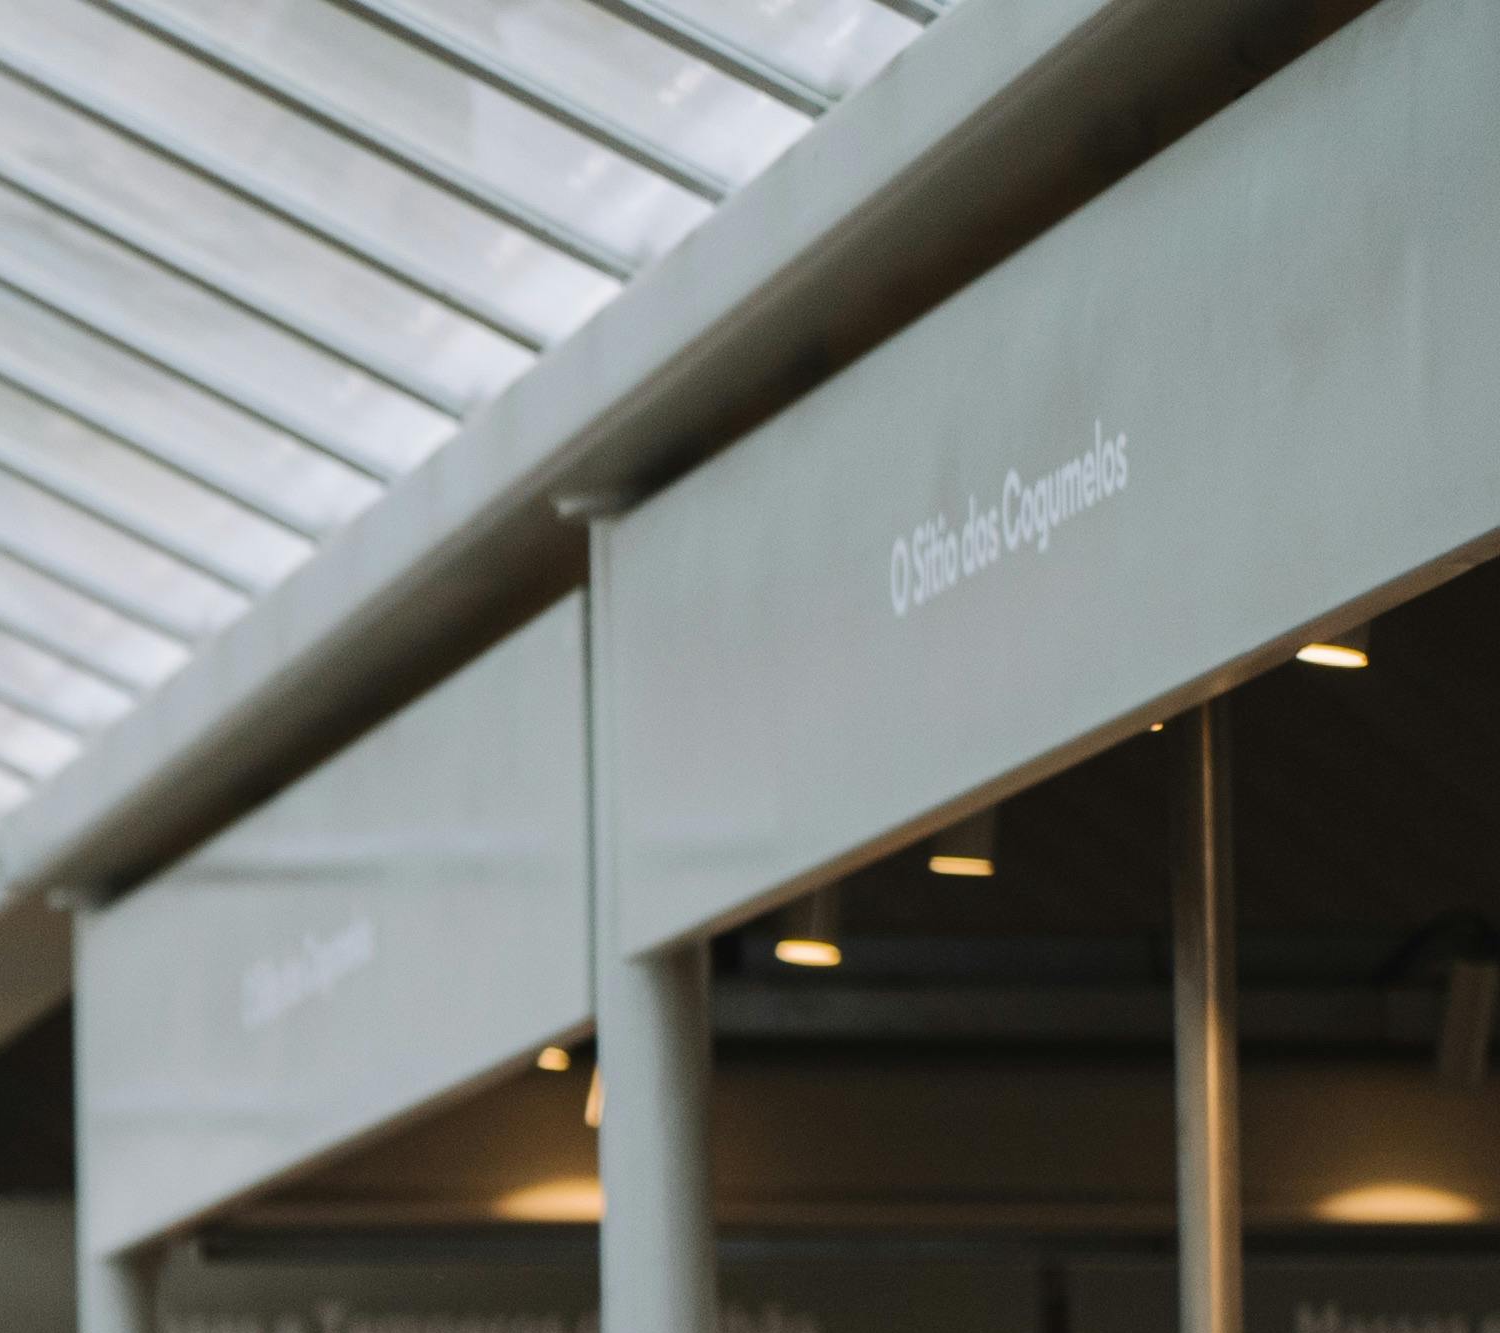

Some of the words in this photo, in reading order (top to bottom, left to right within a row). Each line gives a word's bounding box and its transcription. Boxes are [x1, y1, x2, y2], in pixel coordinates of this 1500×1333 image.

[891, 536, 909, 616] O
[962, 493, 998, 575] dos
[1002, 418, 1127, 552] Cogumelos
